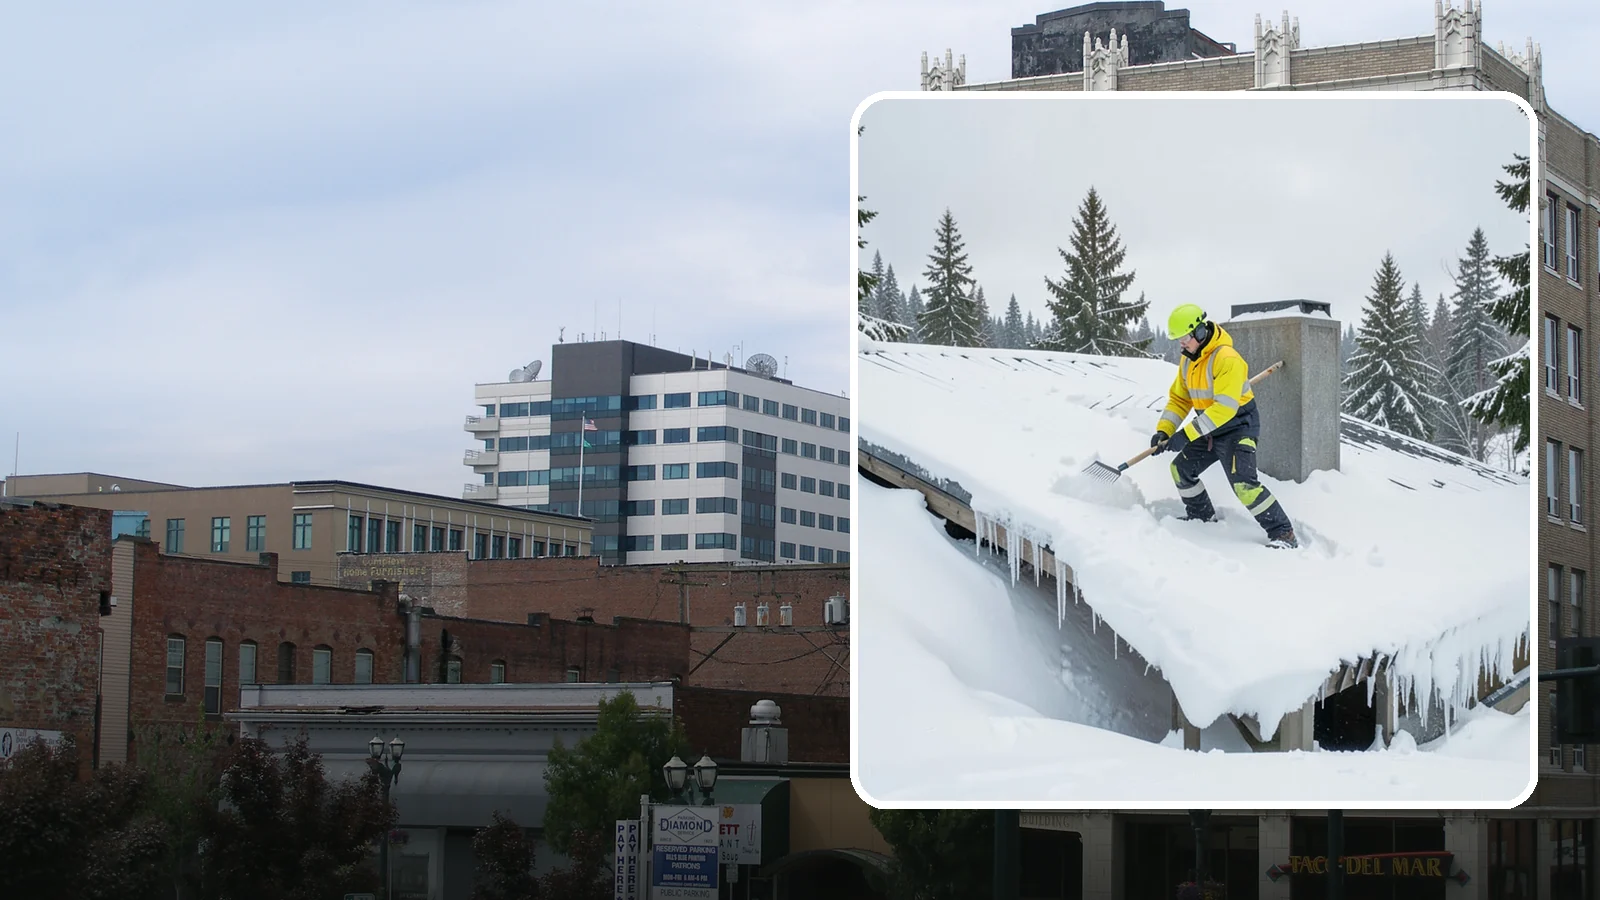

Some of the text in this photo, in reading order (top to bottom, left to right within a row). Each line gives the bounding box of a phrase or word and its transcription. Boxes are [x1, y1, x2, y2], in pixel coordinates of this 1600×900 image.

[343, 566, 427, 577] Home Furnishers
[660, 818, 713, 833] DIAMOND
[1022, 815, 1070, 828] BUILDING
[656, 845, 716, 854] RESERVED PARKING
[616, 824, 625, 894] PAY HERE
[627, 824, 637, 894] PAY HERE
[721, 851, 739, 862] Soup
[671, 862, 701, 870] PATRONS
[1345, 856, 1385, 876] DEL
[1392, 857, 1443, 877] MAR
[660, 888, 710, 898] PUBLIC PARKING
